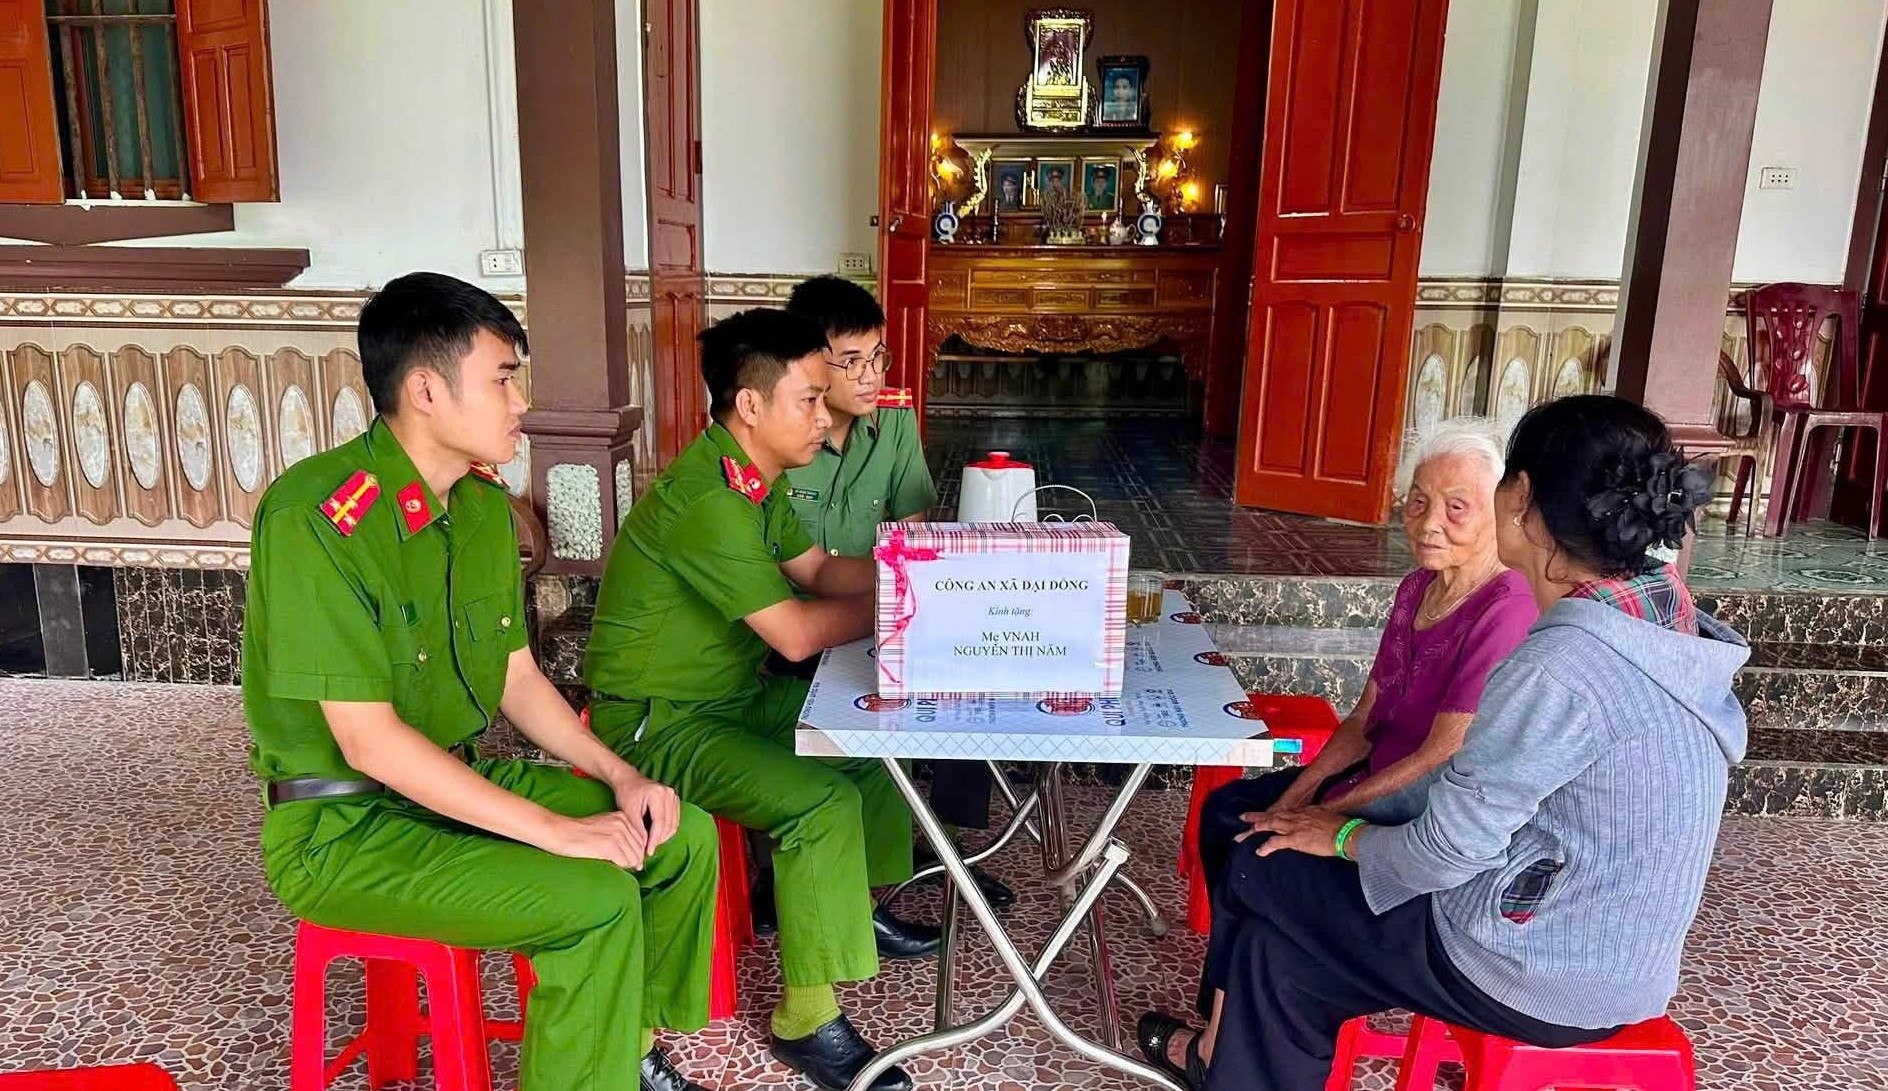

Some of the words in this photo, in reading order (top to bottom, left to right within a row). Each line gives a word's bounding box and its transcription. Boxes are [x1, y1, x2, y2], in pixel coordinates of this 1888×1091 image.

[935, 578, 974, 591] CÔNG
[978, 580, 996, 590] AN
[1000, 578, 1018, 590] XÃ
[1003, 631, 1040, 642] VNAH
[1011, 645, 1033, 658] THỊ
